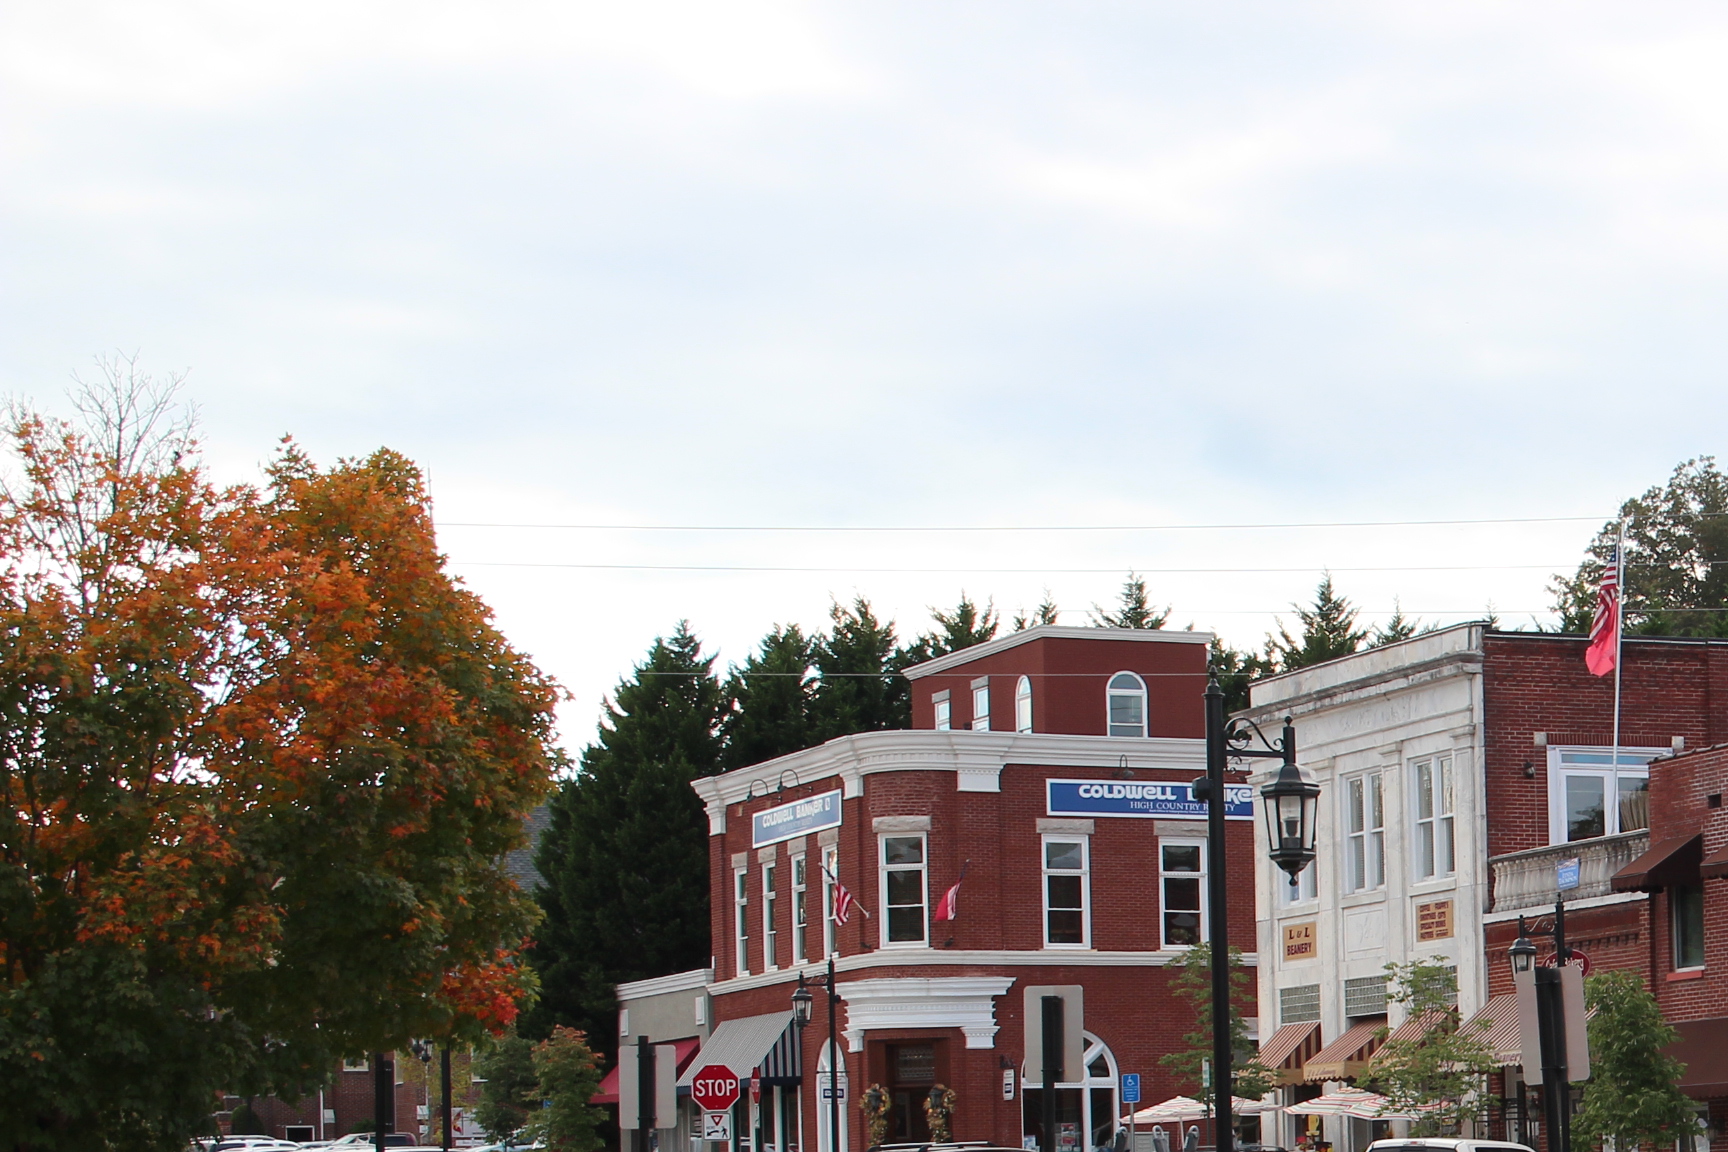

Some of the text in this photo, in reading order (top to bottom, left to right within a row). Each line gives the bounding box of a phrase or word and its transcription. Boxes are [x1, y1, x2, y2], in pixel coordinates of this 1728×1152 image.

[1078, 784, 1178, 801] COLDWELL
[762, 808, 794, 829] COLDWELL
[796, 799, 824, 818] BANKER
[1130, 802, 1236, 812] HIGH COUNTRY RTY
[1288, 929, 1295, 940] L
[1304, 926, 1310, 938] L
[1287, 941, 1312, 956] BEANERY
[695, 1079, 737, 1097] STOP
